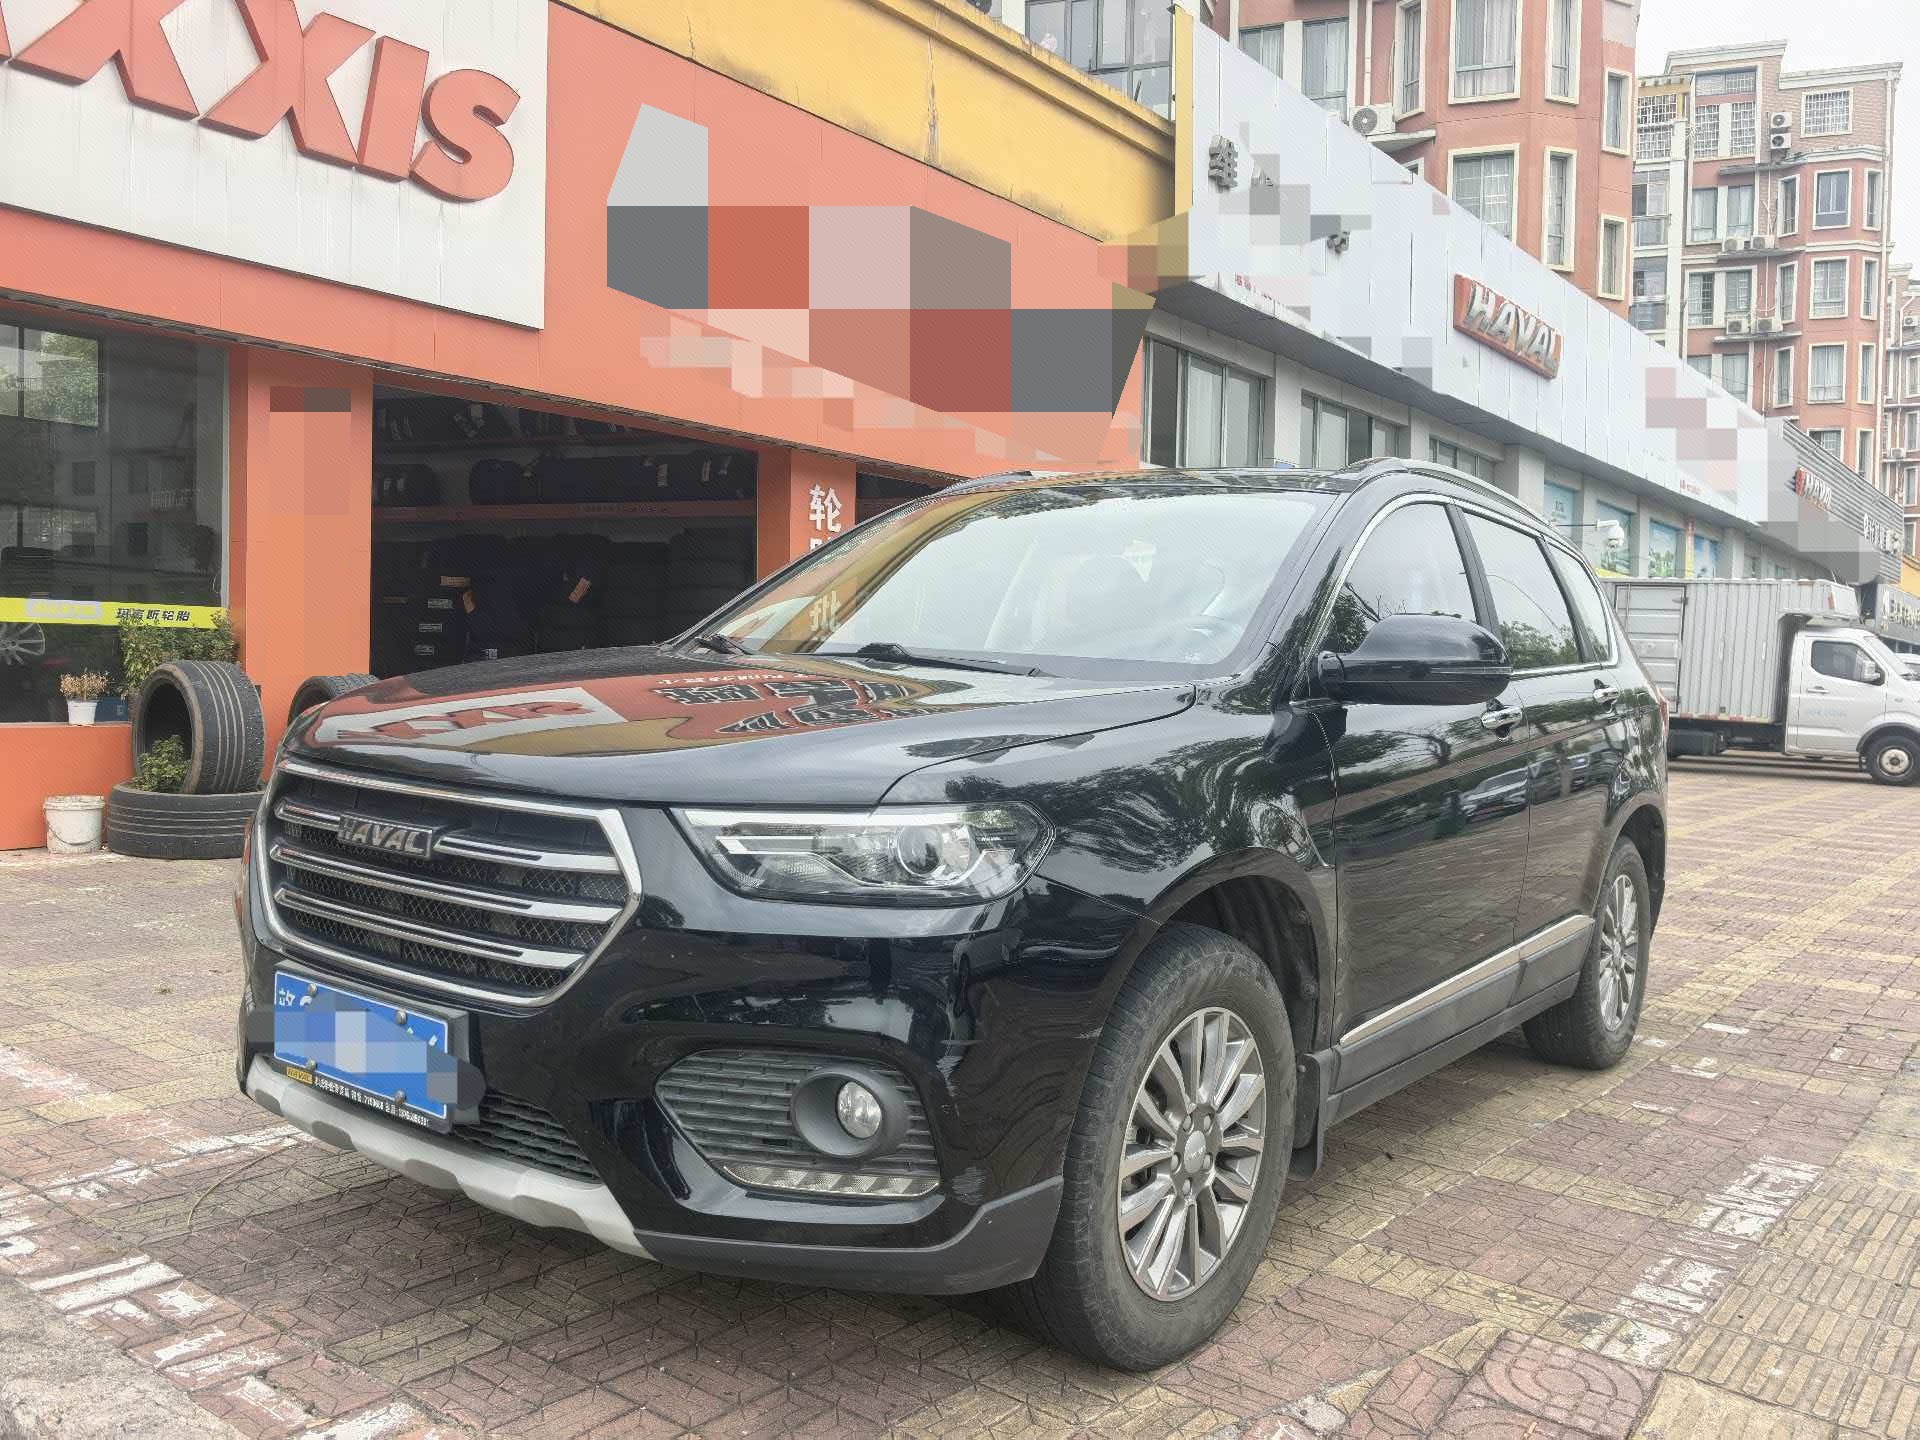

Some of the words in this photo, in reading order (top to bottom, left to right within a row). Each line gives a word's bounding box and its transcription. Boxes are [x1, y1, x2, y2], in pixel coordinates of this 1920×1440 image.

[0, 0, 521, 203] XXIS
[1464, 281, 1558, 373] HAVAL
[337, 818, 424, 856] HAVAL
